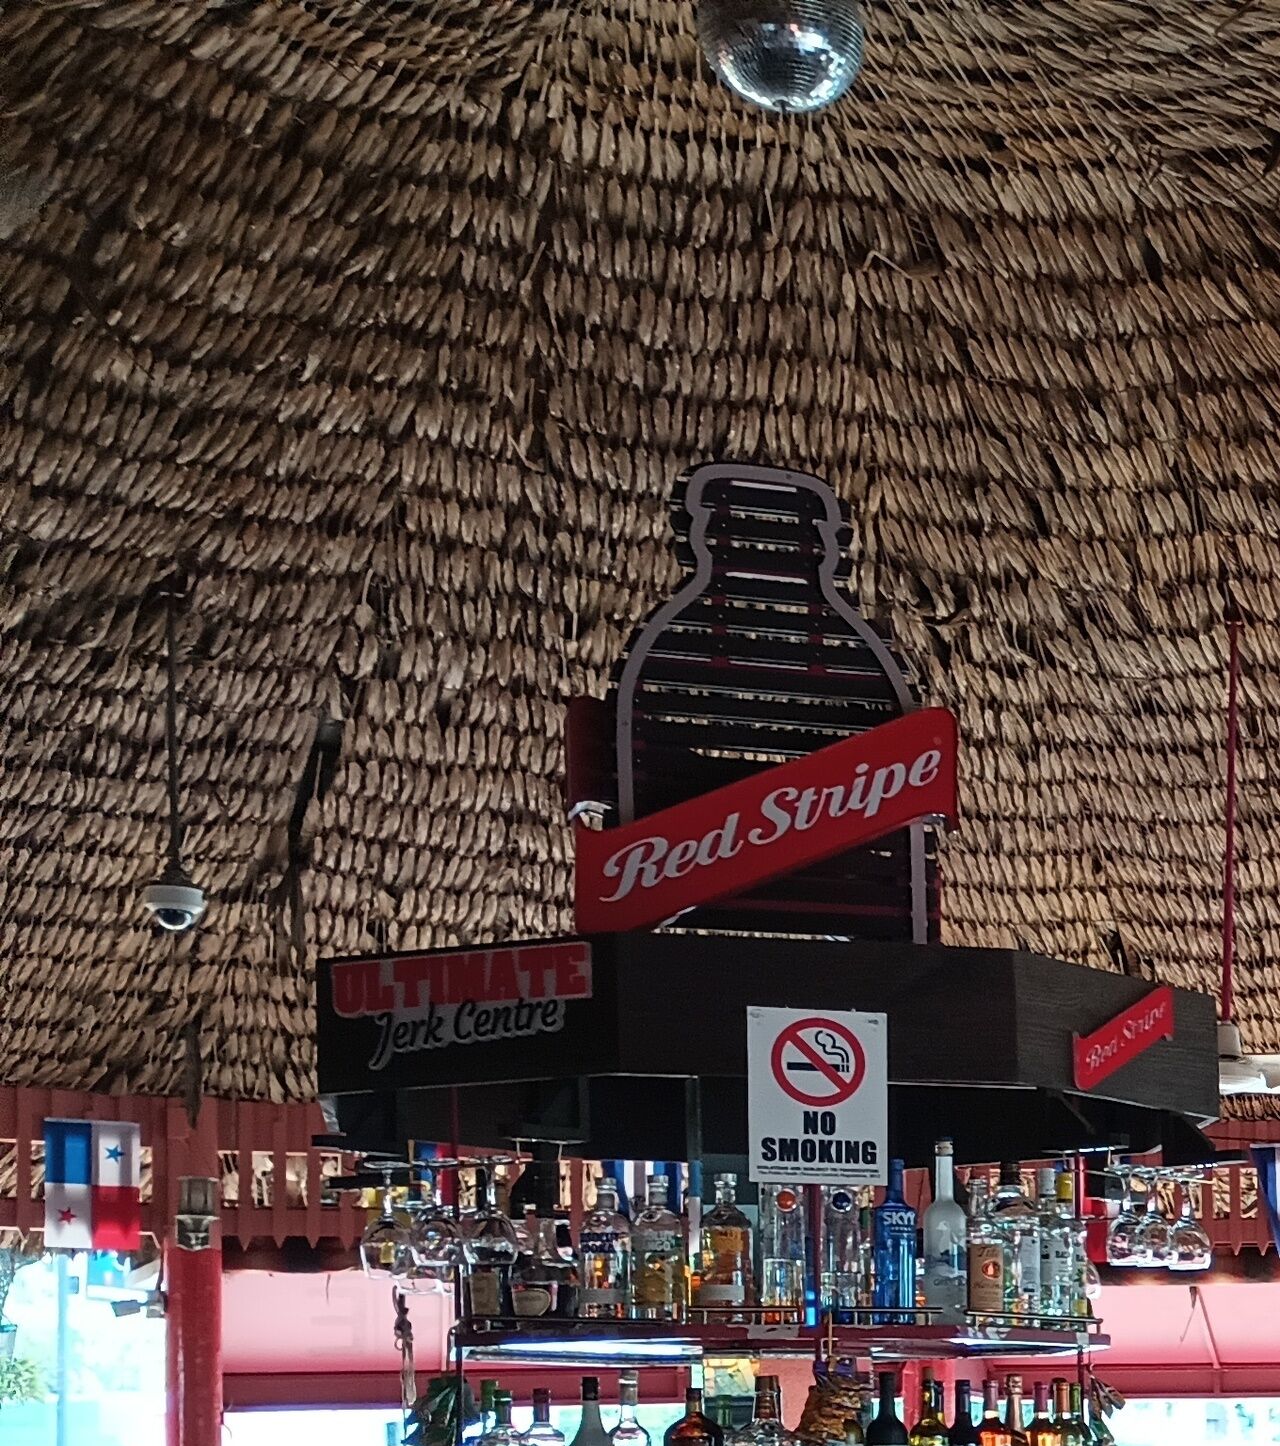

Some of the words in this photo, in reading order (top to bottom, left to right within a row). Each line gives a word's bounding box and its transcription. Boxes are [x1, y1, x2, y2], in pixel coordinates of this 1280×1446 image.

[598, 812, 744, 903] Red
[748, 749, 942, 846] Stripe
[331, 941, 592, 1017] ULTIMATE
[370, 1002, 444, 1068] Jerk
[453, 997, 559, 1040] Centre
[803, 1110, 837, 1136] NO
[761, 1136, 877, 1165] SMOKING
[882, 1211, 916, 1226] SKYY
